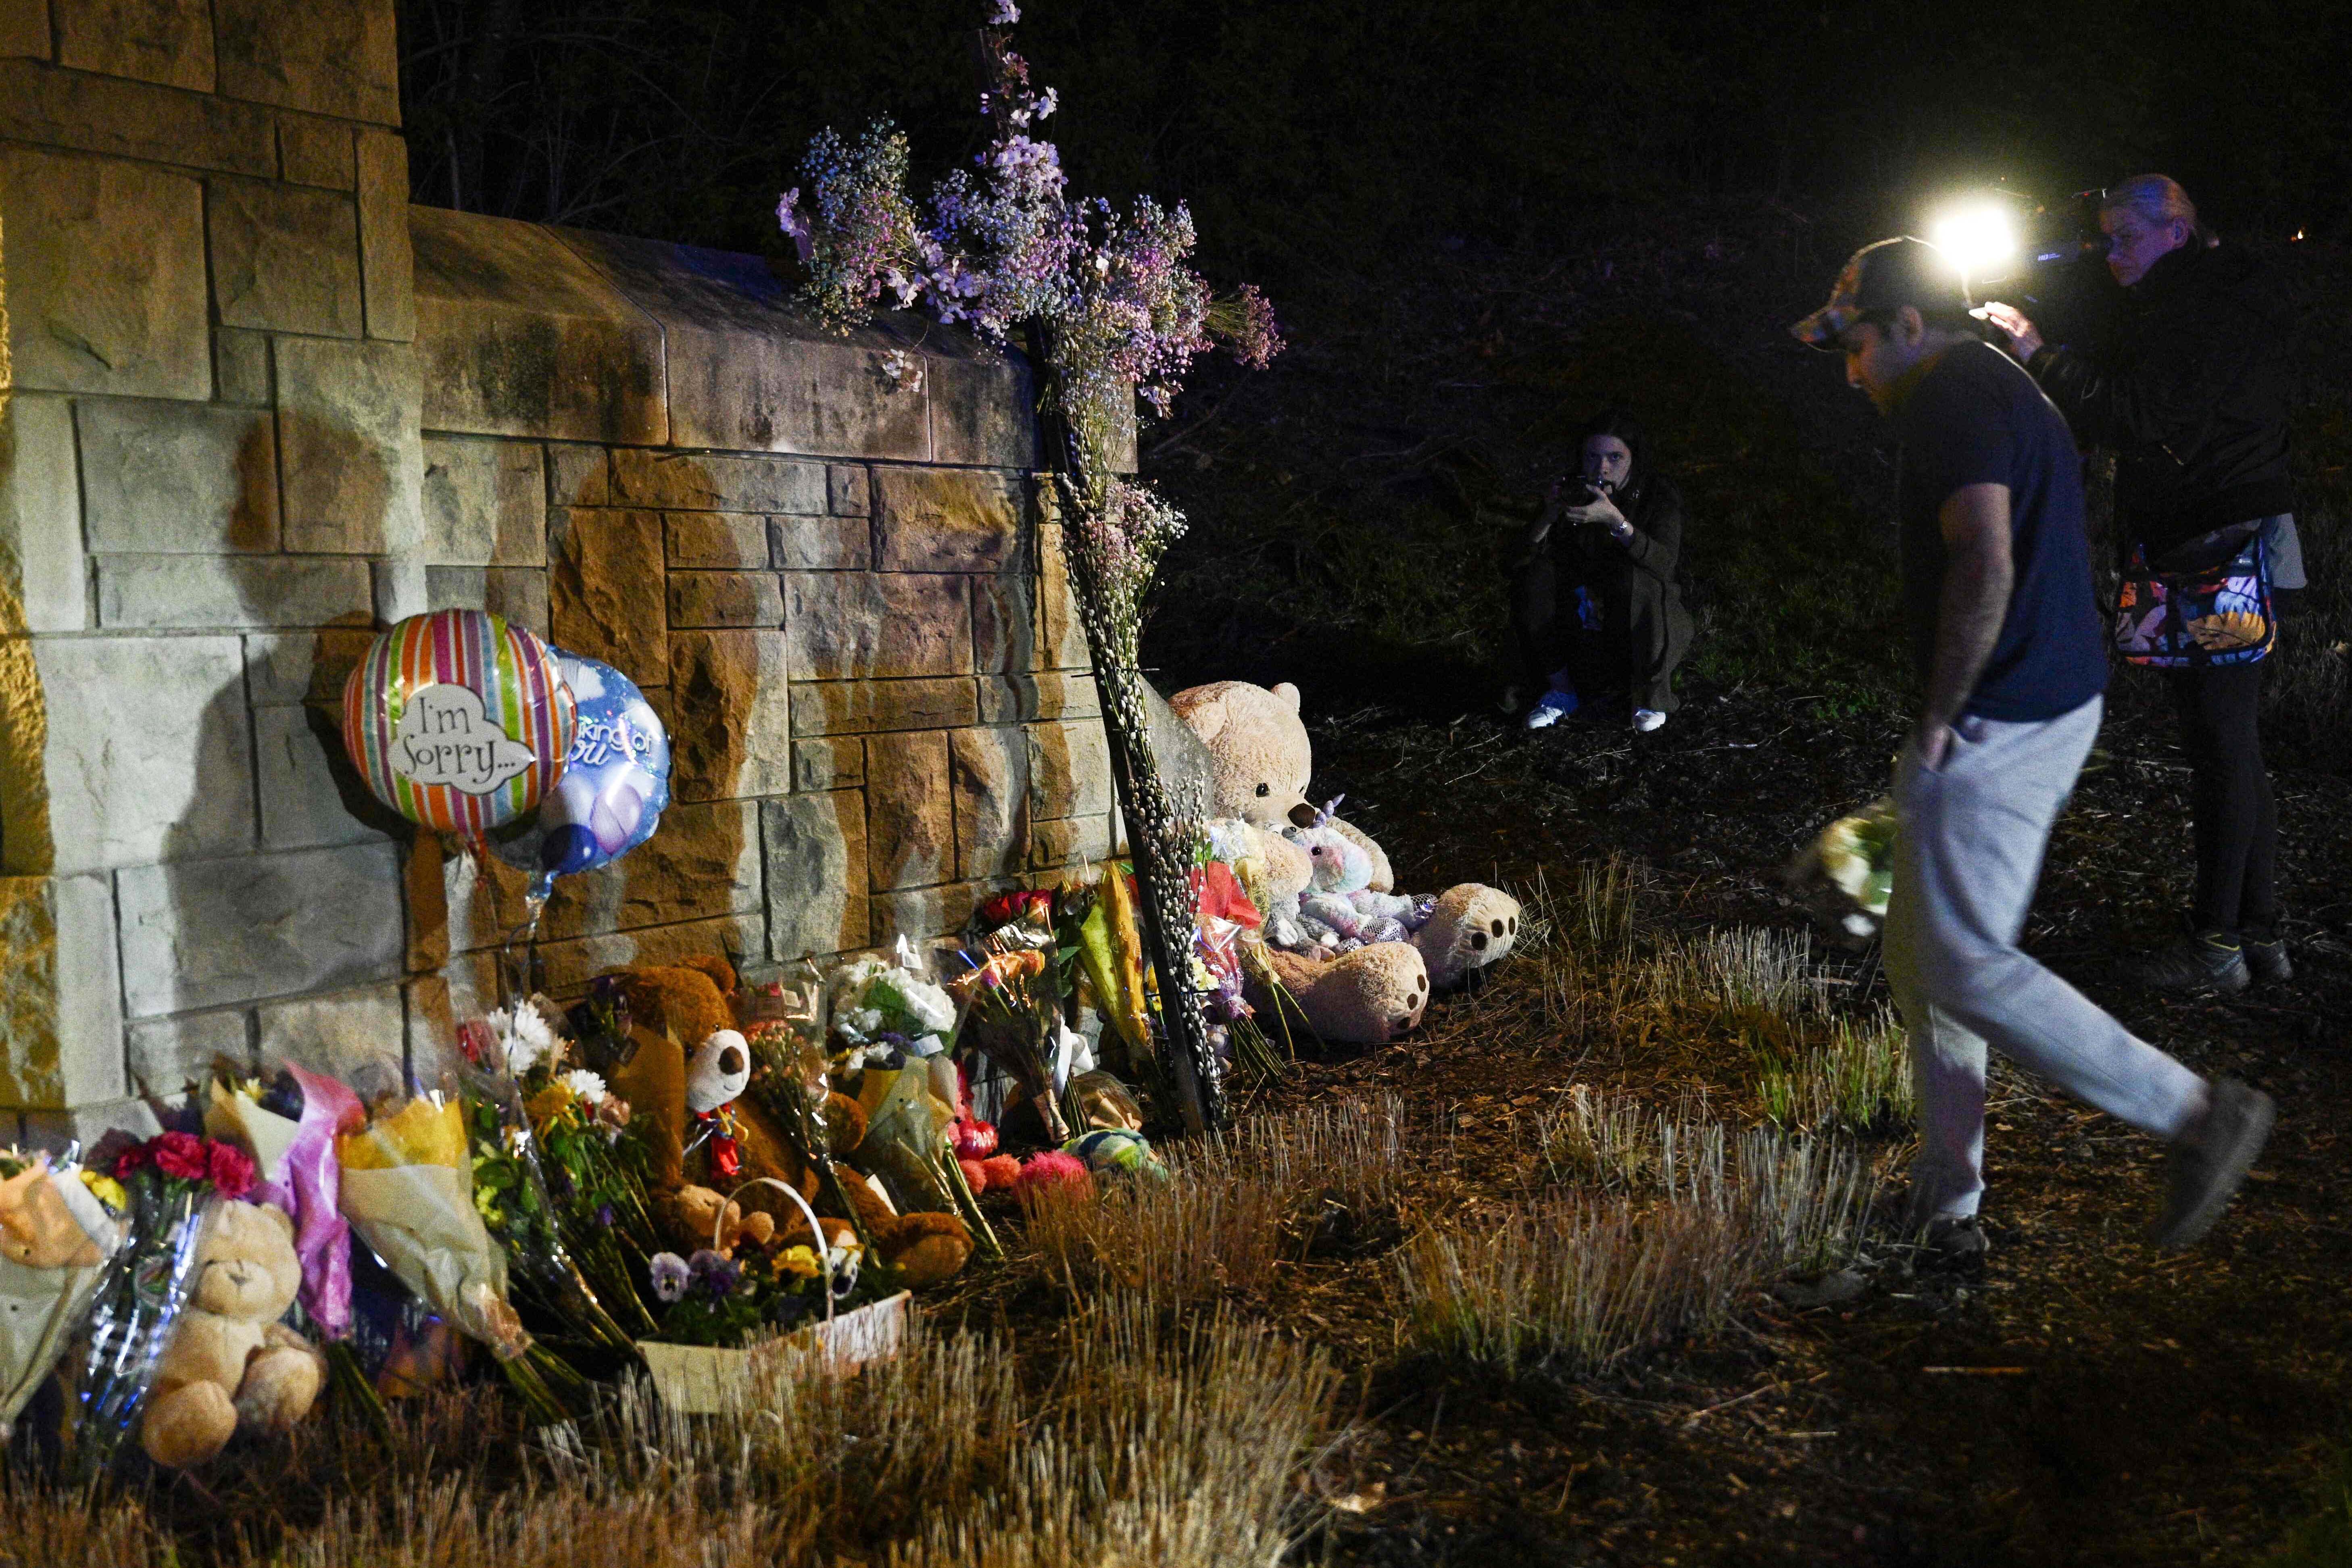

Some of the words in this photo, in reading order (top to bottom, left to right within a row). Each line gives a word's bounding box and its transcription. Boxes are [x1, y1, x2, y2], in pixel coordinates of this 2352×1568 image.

[419, 697, 472, 734] I'm
[568, 738, 611, 765] ou
[578, 717, 628, 751] king
[632, 731, 653, 753] of
